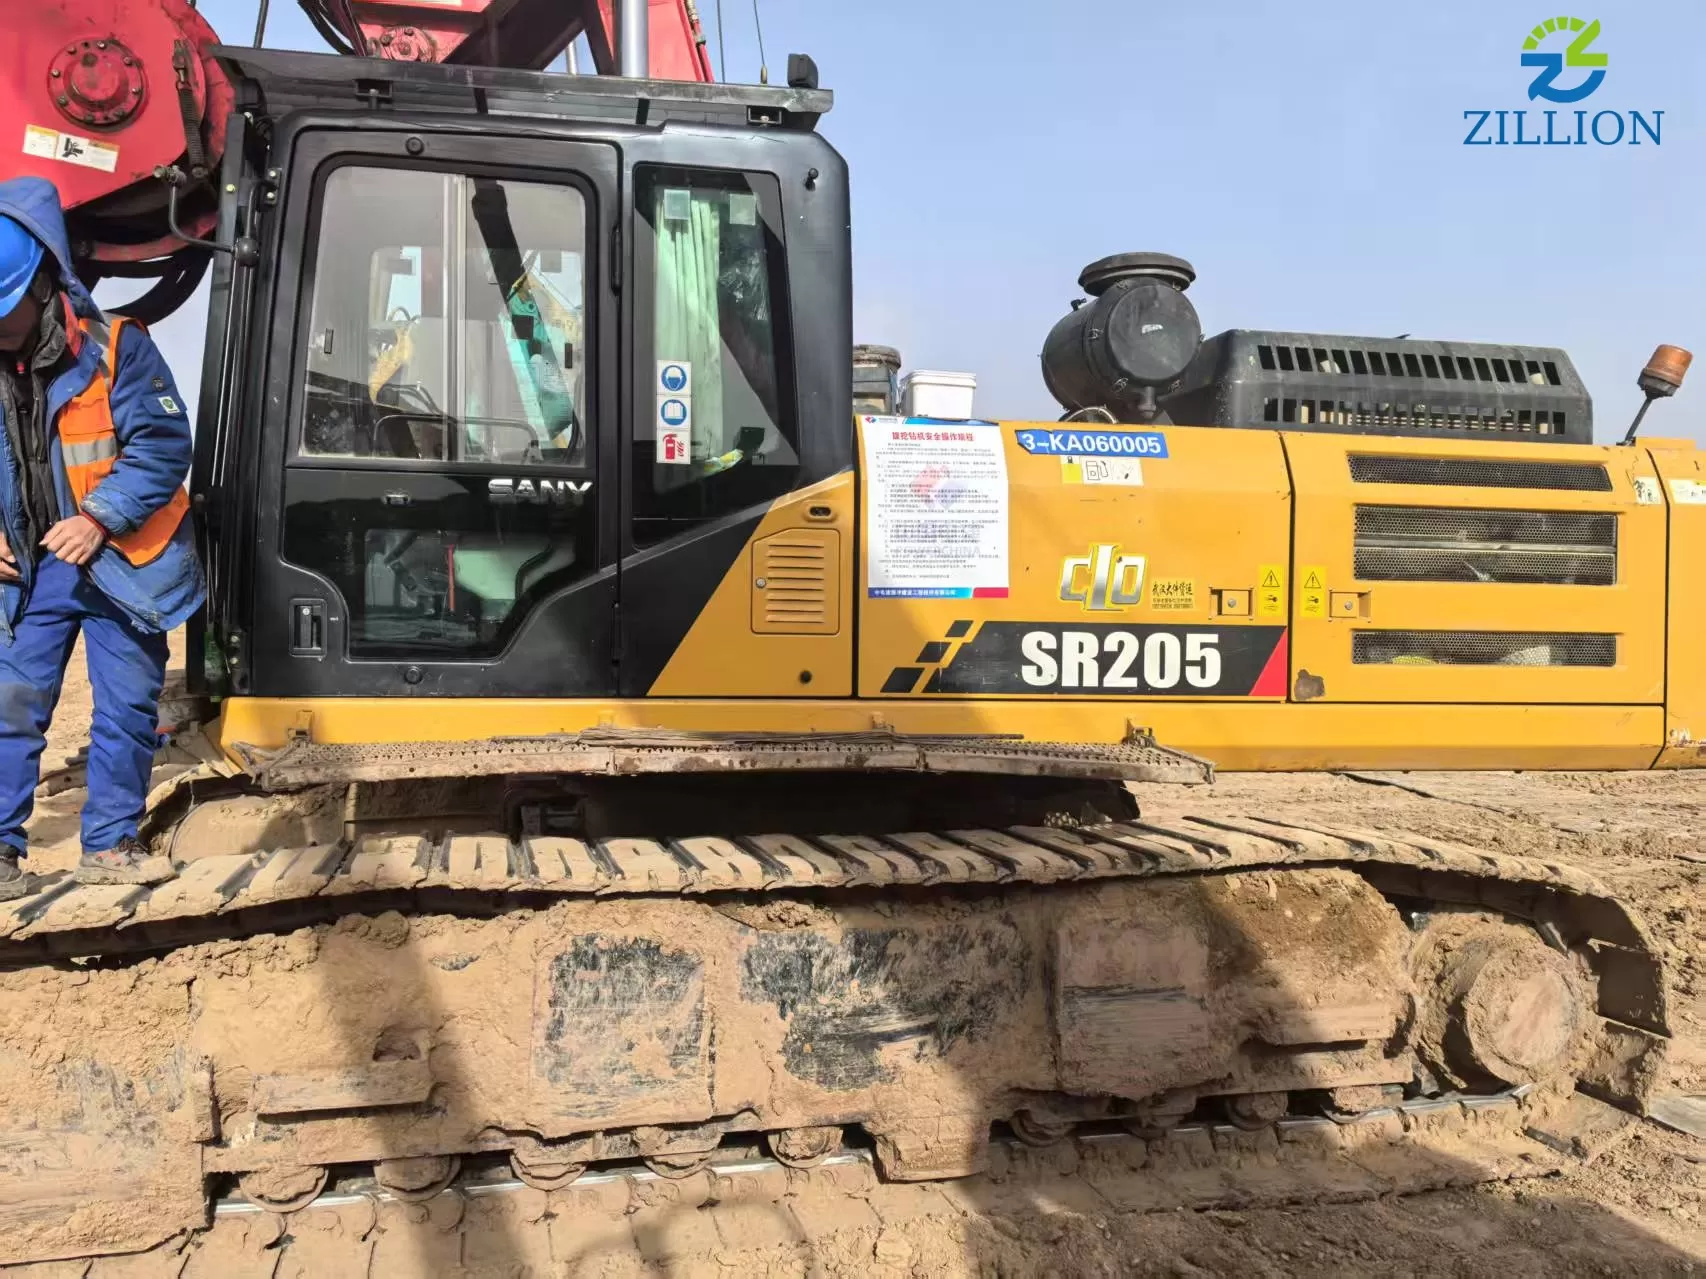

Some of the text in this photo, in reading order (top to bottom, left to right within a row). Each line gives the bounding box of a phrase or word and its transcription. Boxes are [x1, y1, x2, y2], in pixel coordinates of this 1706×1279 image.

[1021, 433, 1161, 453] 3-KA060005
[488, 478, 593, 502] SANY
[1021, 631, 1221, 688] SR205
